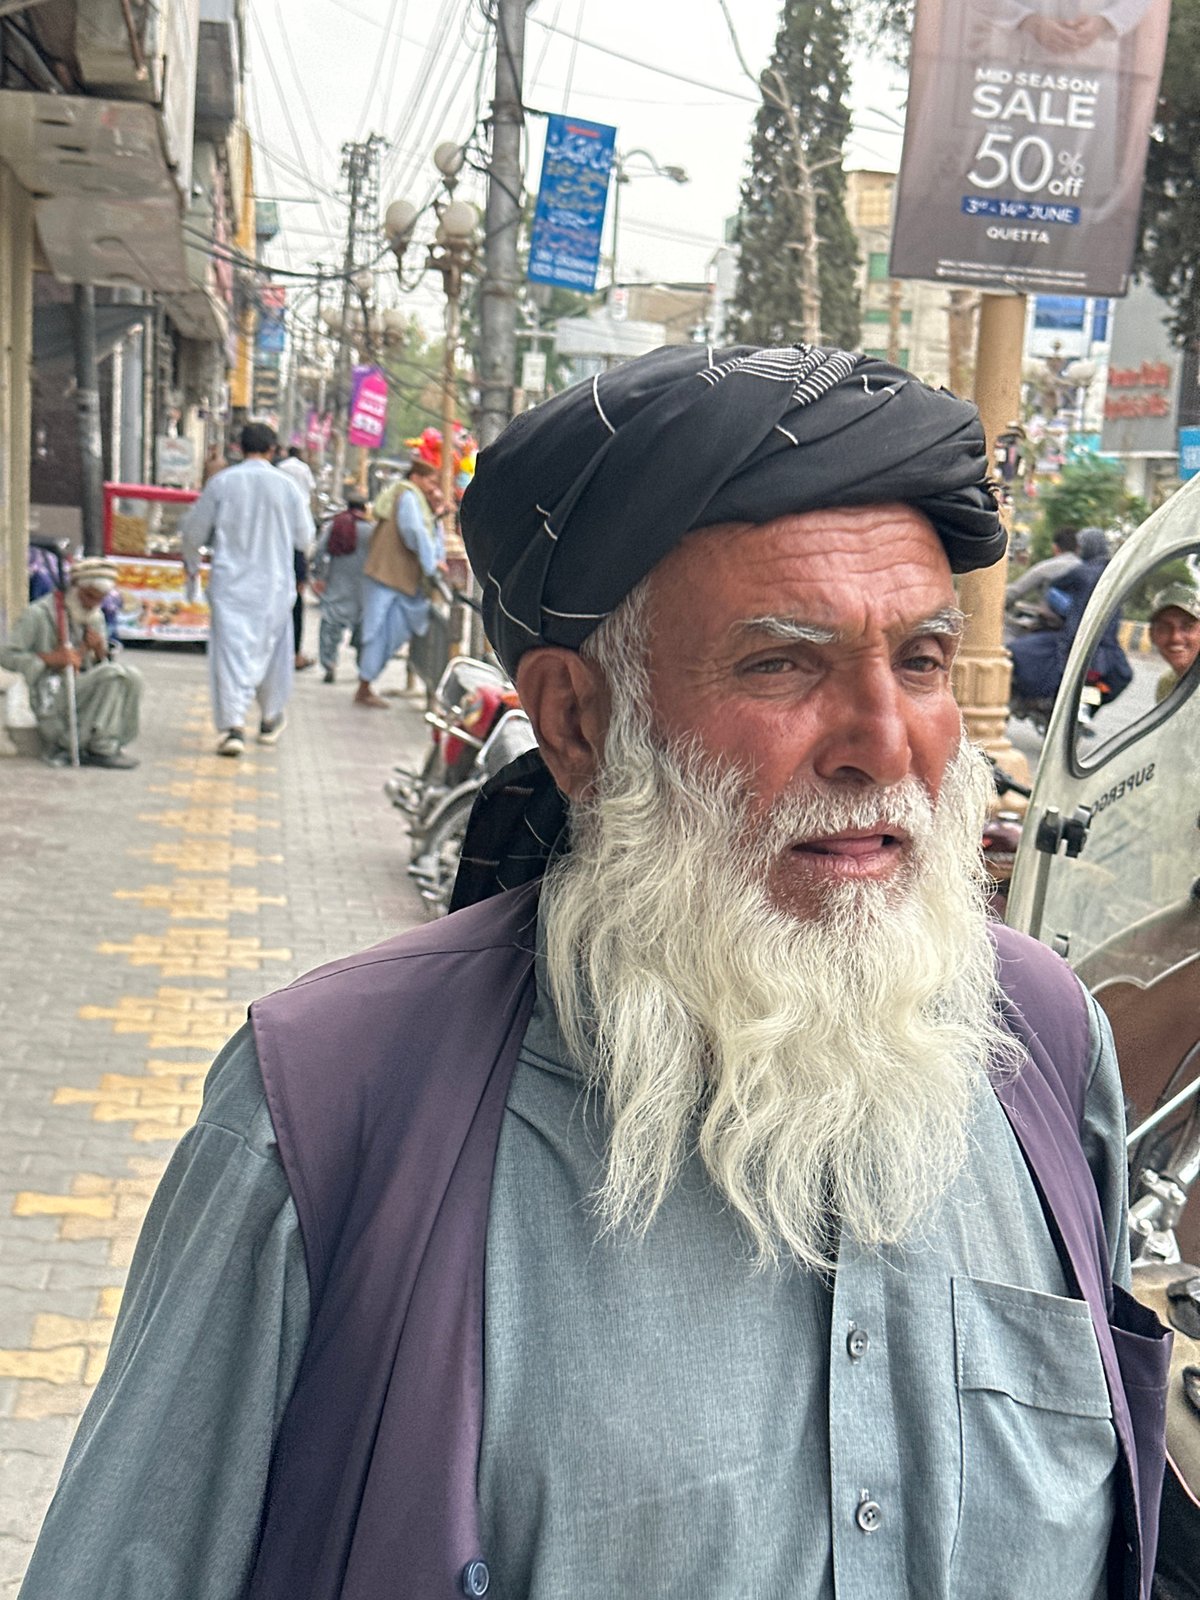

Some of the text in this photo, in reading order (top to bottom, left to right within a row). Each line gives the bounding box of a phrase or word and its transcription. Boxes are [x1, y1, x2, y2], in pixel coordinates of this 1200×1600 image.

[975, 67, 1100, 94] MID SEASON
[971, 84, 1097, 129] SALE
[1048, 178, 1084, 198] off
[1027, 204, 1074, 223] JUNE
[986, 226, 1050, 244] QUETTA
